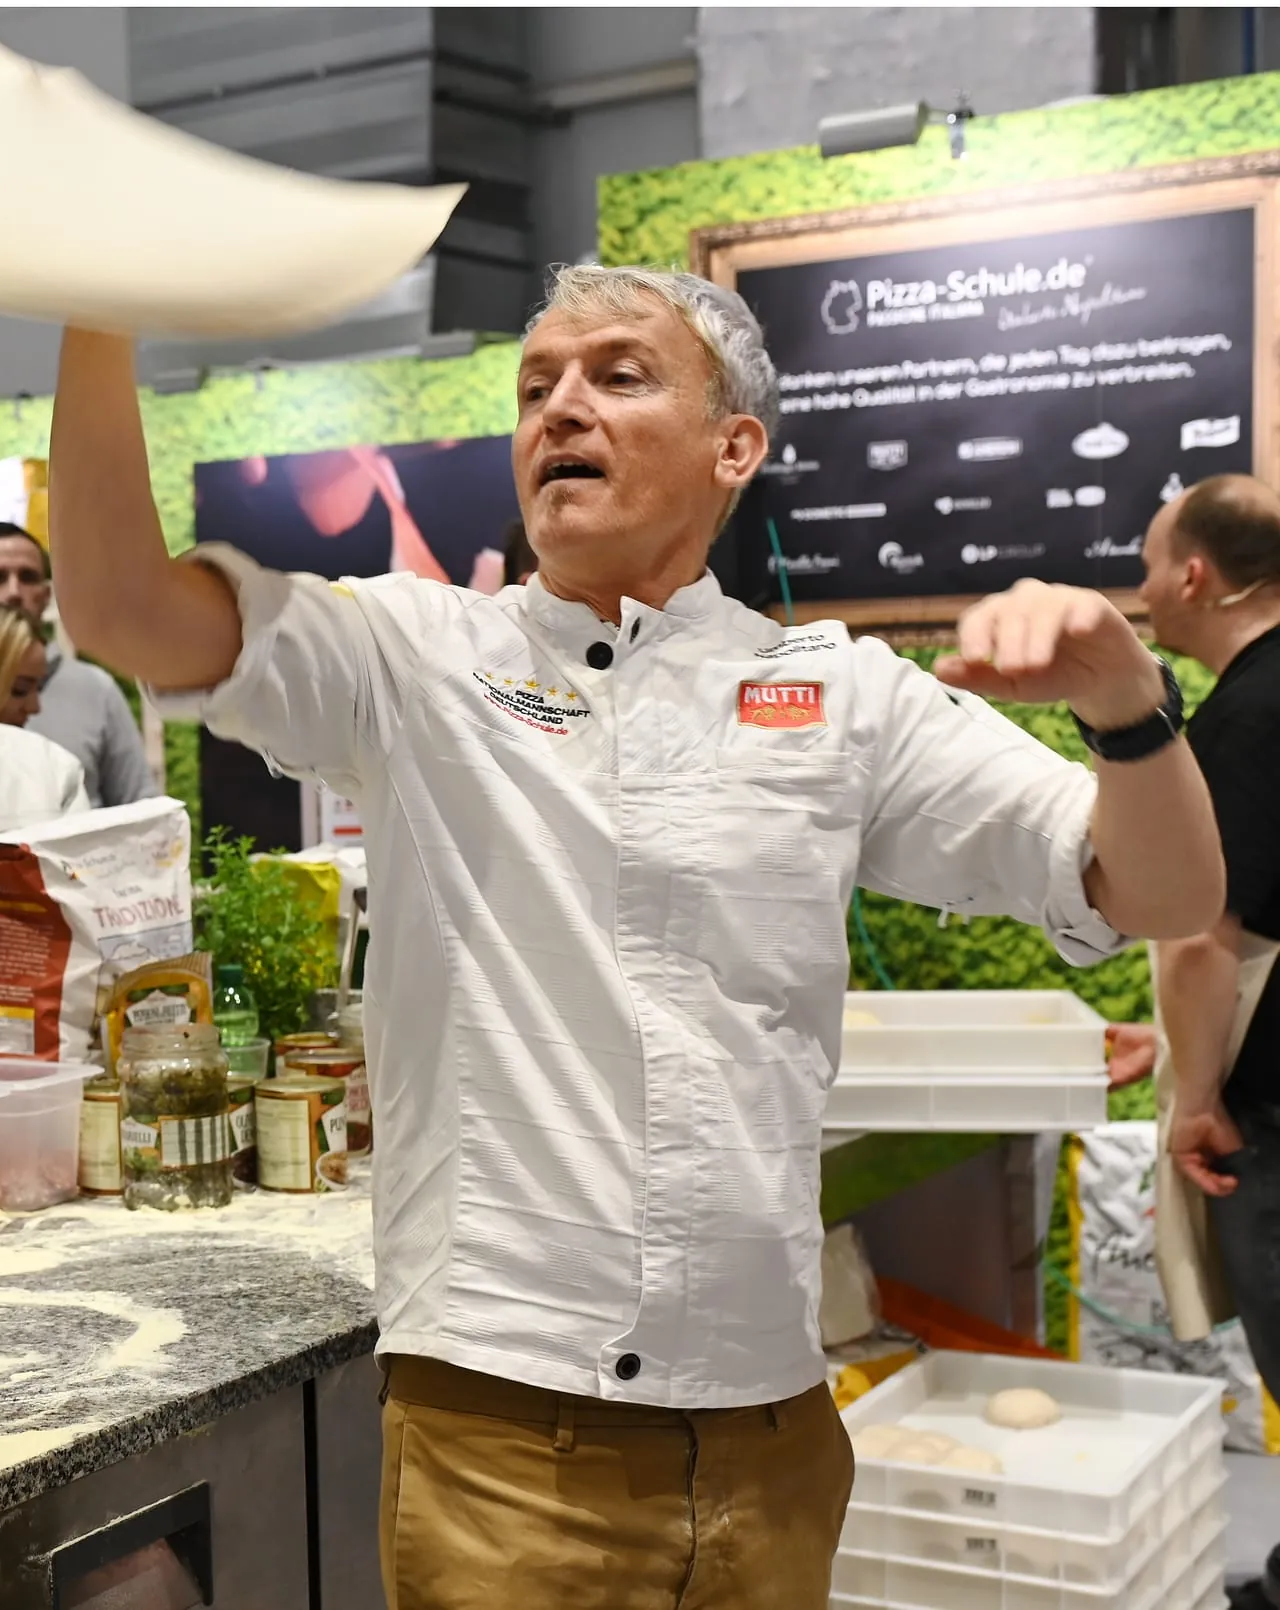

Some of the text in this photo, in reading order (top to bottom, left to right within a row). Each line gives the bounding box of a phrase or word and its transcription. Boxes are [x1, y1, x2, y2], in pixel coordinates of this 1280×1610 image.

[837, 365, 901, 386] unseren
[979, 352, 1007, 372] die
[1008, 348, 1057, 374] jeden
[1058, 344, 1091, 367] Tag
[1092, 341, 1137, 361] dazu
[812, 391, 851, 410] hohe
[852, 384, 915, 407] Qualität
[916, 384, 934, 402] in
[934, 380, 964, 400] der
[965, 372, 1070, 397] Gastronomie
[1071, 371, 1095, 388] zu
[473, 672, 590, 718] NATIONALMANNSCHAFT
[489, 691, 563, 724] DEUTSCHLAND
[515, 690, 545, 704] PIZZA
[744, 686, 815, 704] MUTTI
